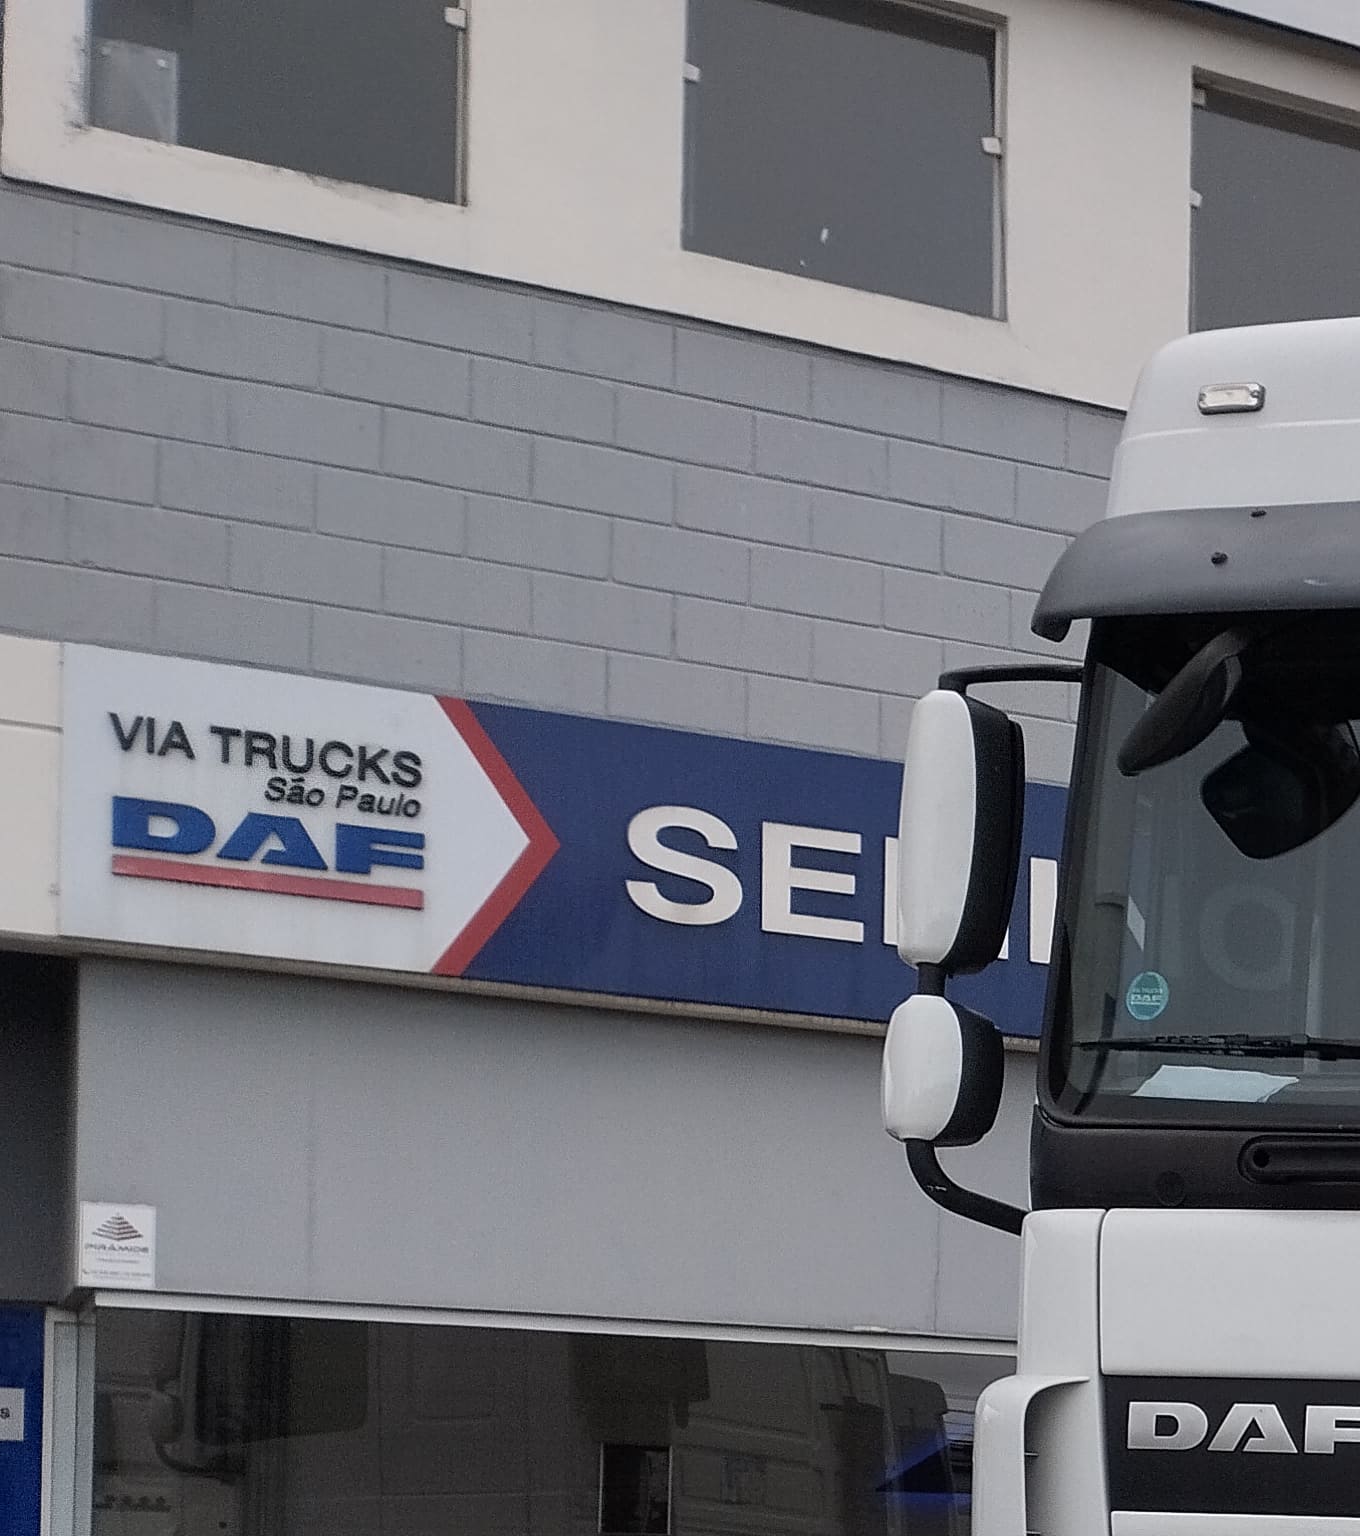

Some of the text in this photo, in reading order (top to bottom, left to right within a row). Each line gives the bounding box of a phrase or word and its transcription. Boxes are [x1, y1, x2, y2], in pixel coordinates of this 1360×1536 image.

[109, 712, 423, 788] VIA TRUCKS
[112, 795, 425, 874] DAF
[264, 776, 422, 818] São Paulo
